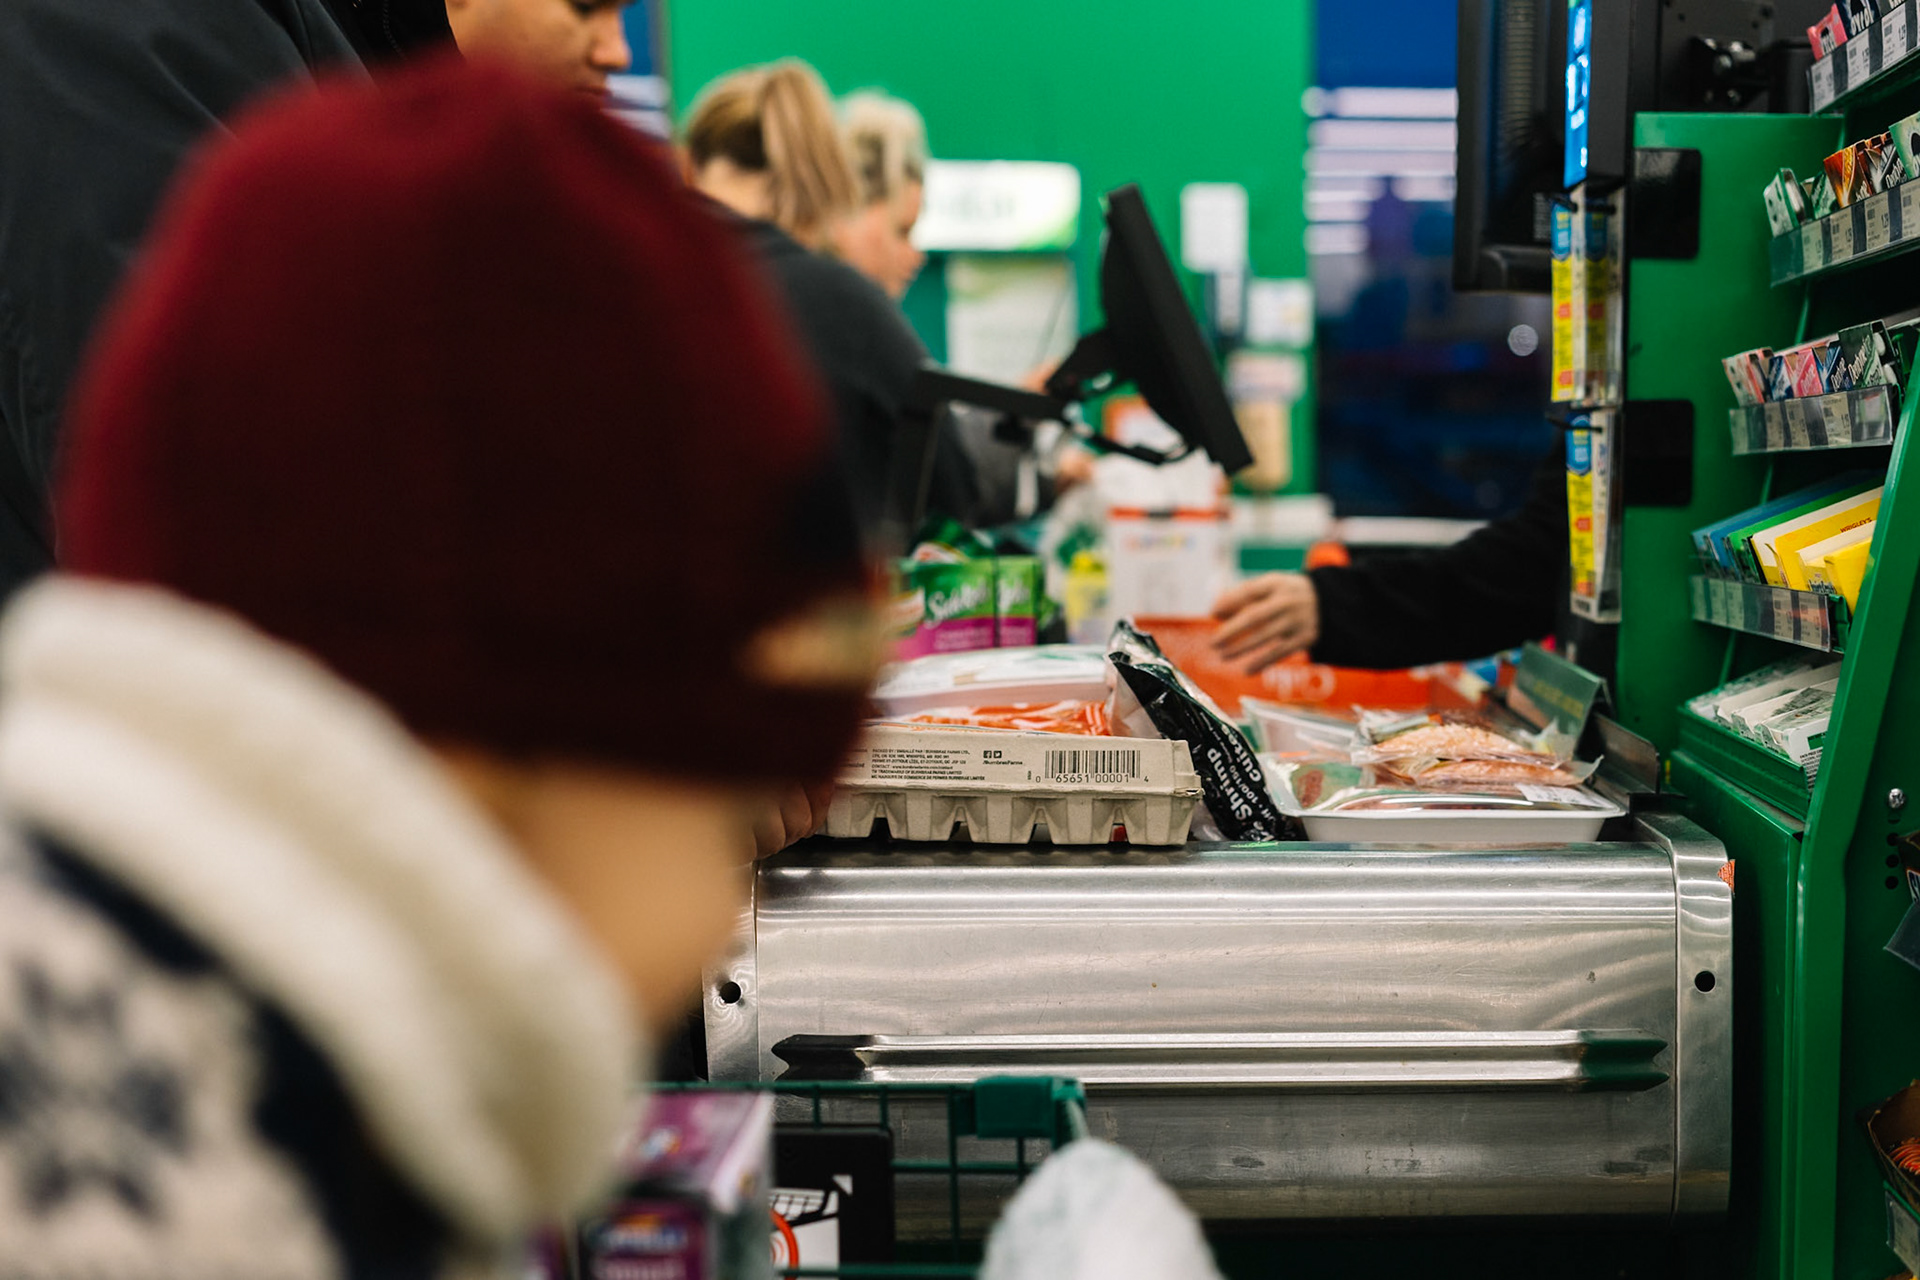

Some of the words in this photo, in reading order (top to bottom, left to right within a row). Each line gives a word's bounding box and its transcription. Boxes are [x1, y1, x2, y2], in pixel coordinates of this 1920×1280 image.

[1035, 775, 1042, 783] 0
[1055, 774, 1090, 783] 65651
[1095, 774, 1129, 783] 00001
[1143, 775, 1149, 783] 4
[1207, 747, 1253, 820] Shrimp
[1229, 765, 1259, 804] 100/150
